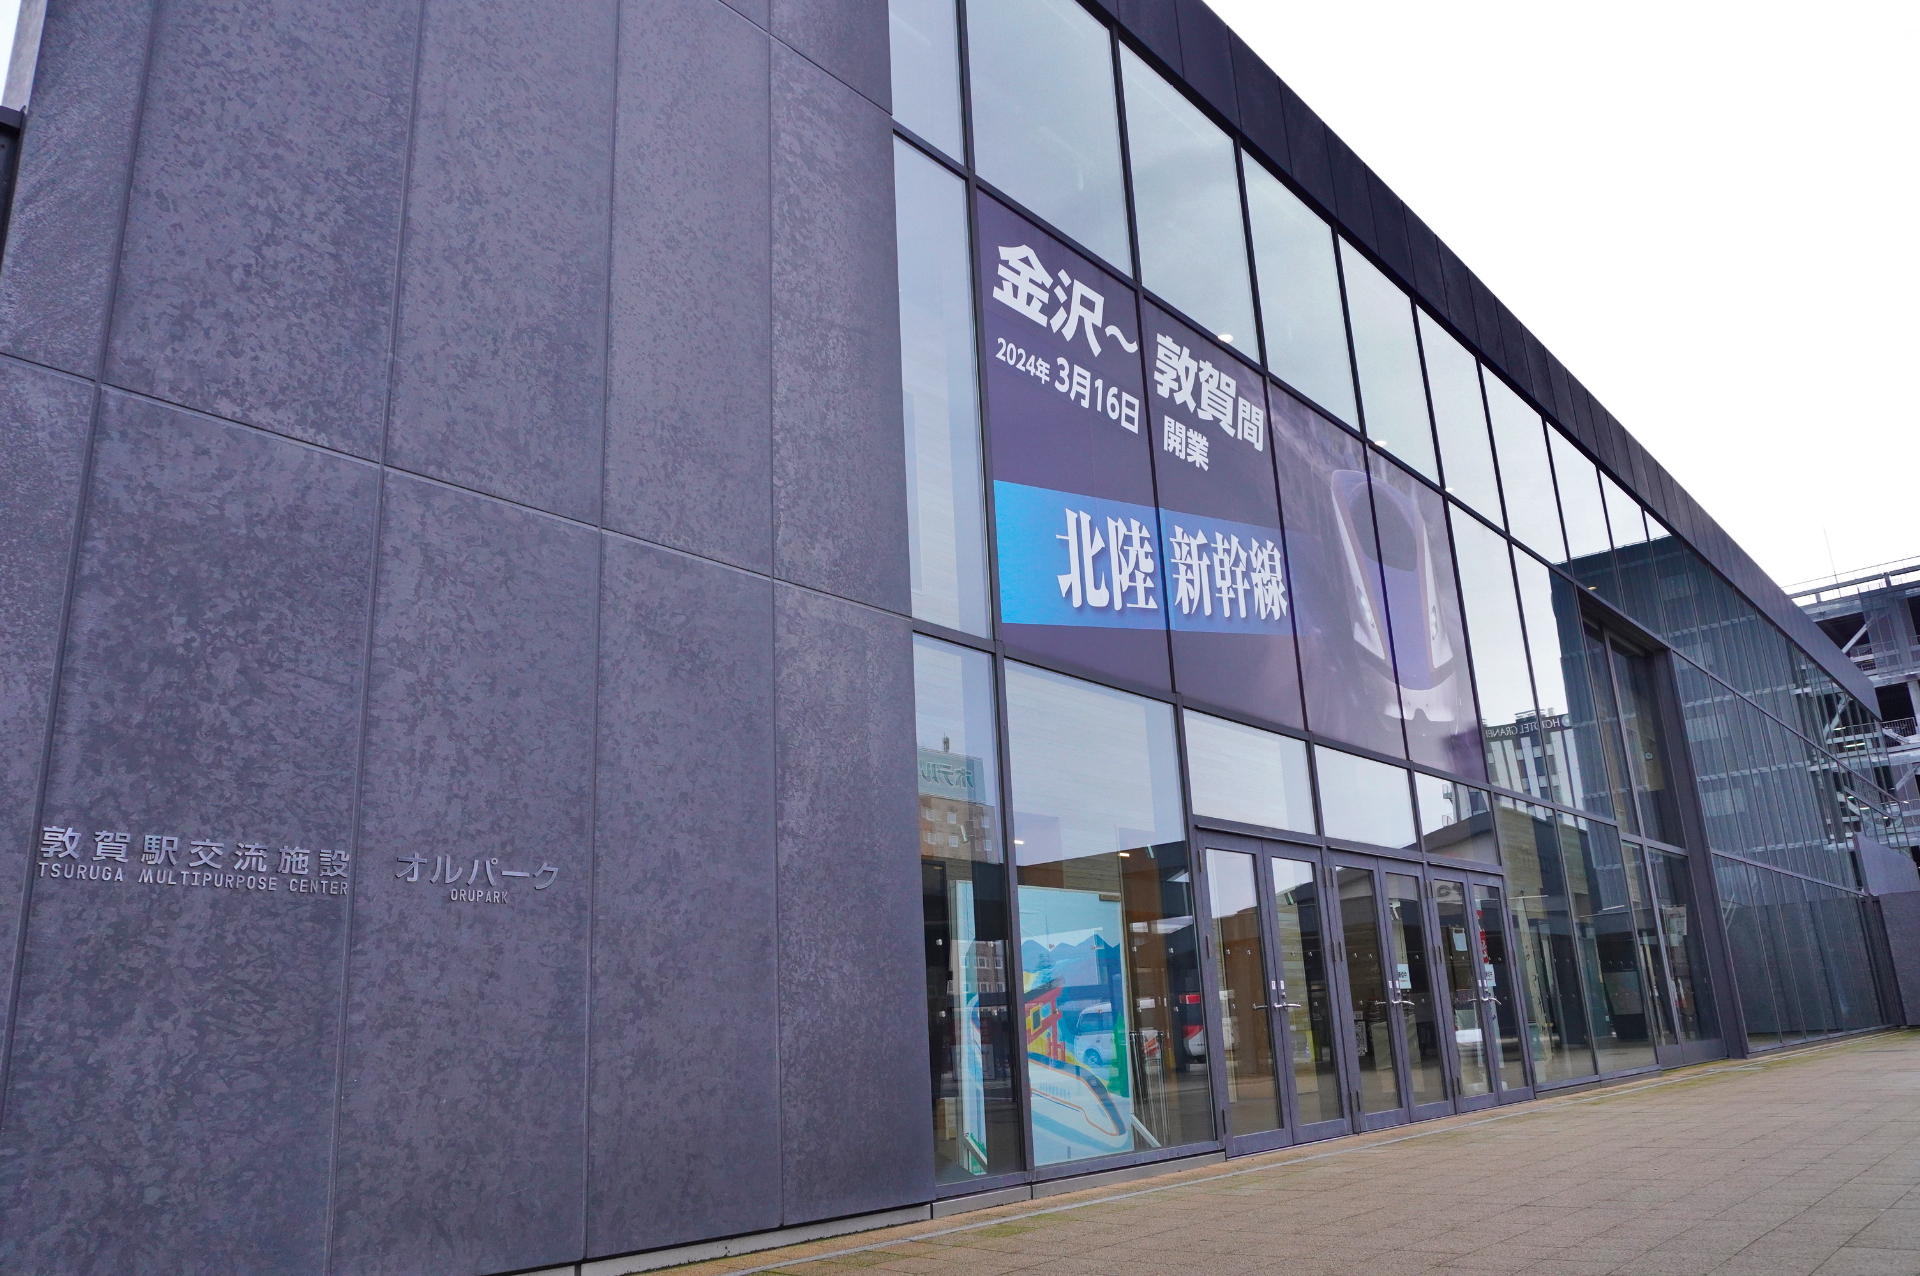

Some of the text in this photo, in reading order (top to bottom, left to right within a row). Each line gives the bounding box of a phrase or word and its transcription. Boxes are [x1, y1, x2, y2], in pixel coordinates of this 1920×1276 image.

[1163, 415, 1209, 471] 開業
[40, 825, 350, 878] 敦賀駅交流施設
[38, 862, 349, 895] TSURUGA MULTIPURPOSE CENTER
[395, 852, 559, 890] オルパーク
[450, 888, 509, 904] ORUPARK
